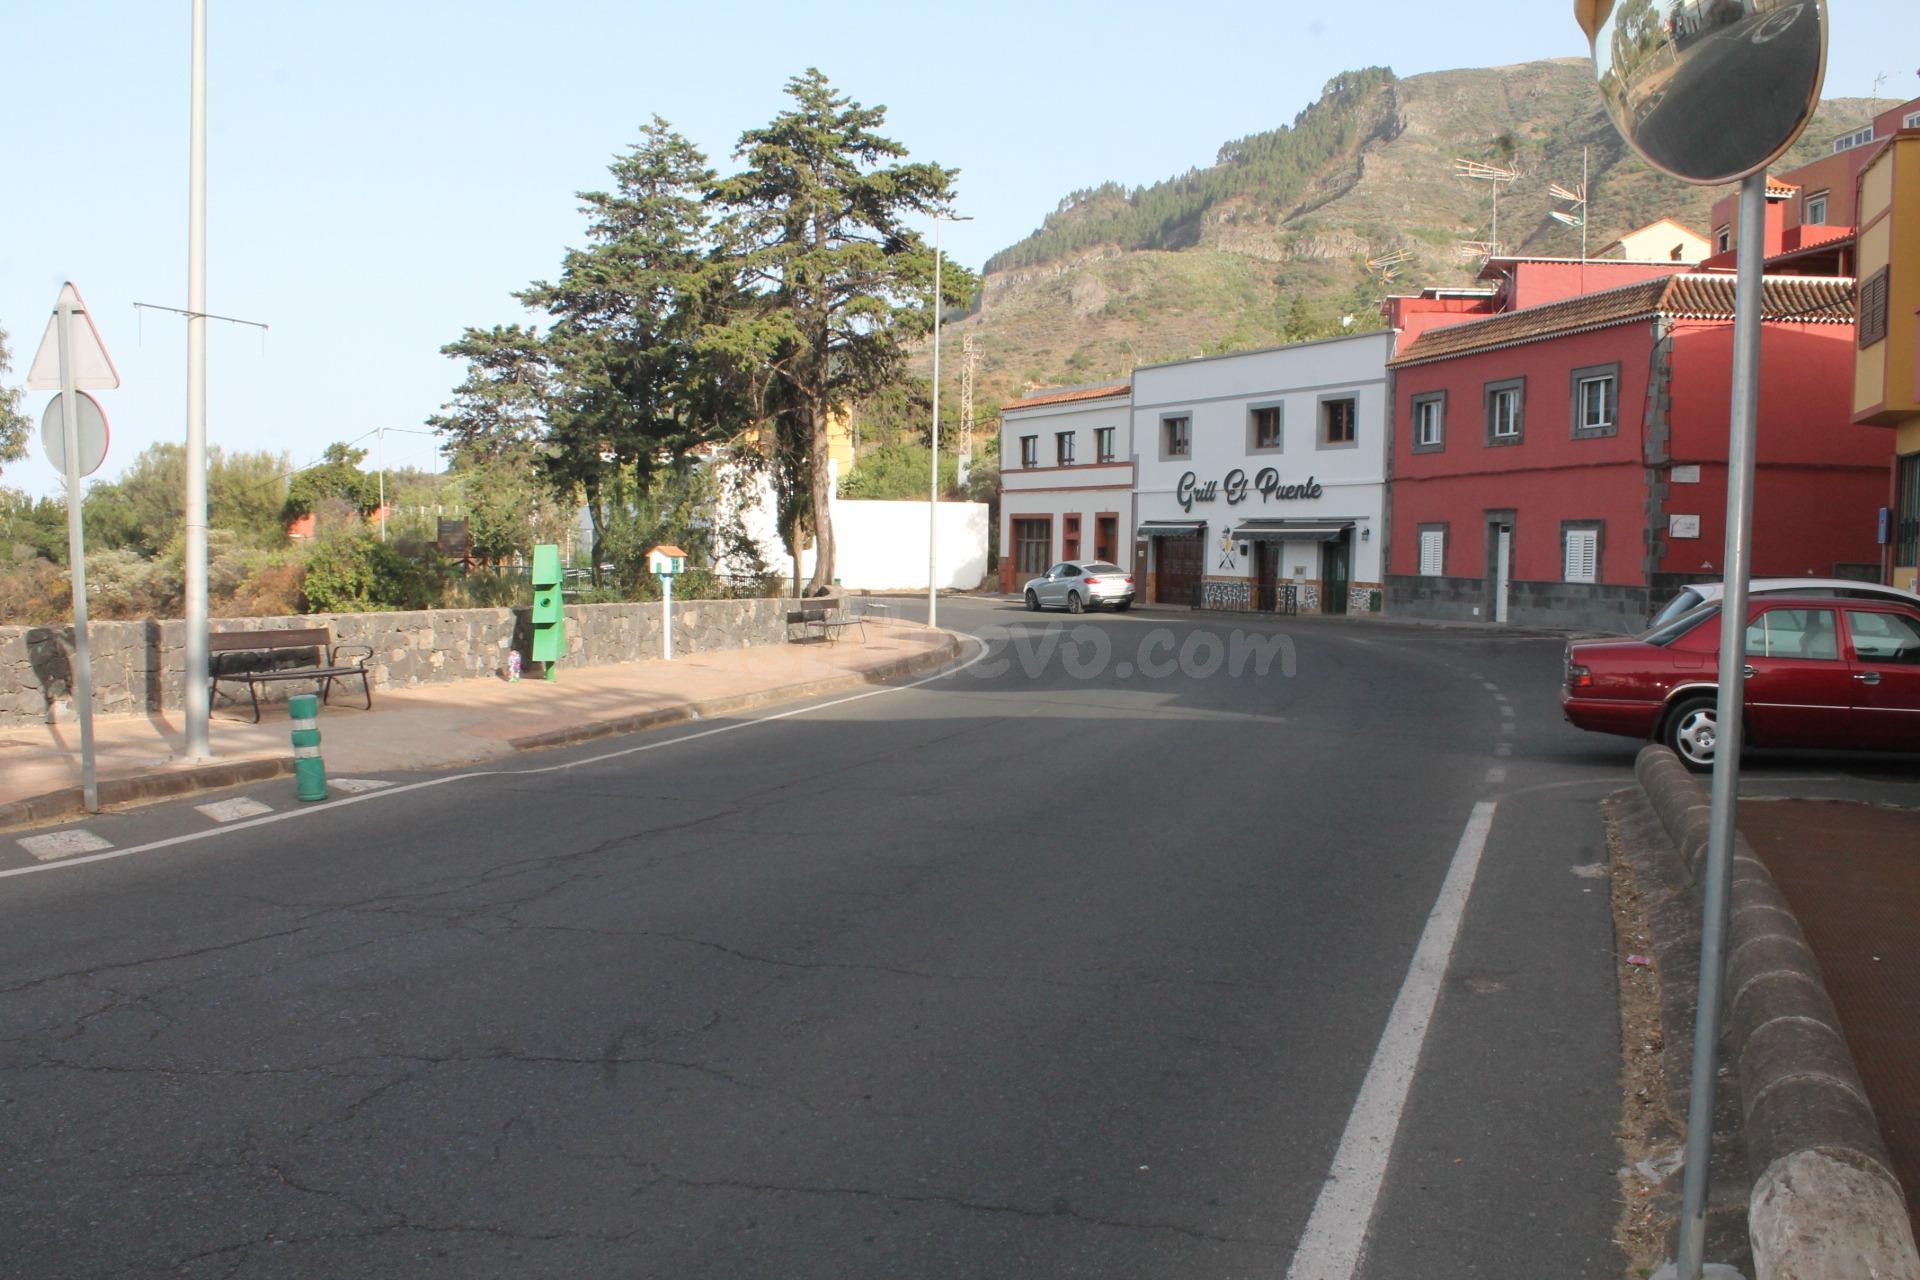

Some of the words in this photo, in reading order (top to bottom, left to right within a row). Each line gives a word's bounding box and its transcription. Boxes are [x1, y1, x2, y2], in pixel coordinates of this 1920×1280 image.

[1177, 471, 1218, 513] Grill
[1224, 468, 1249, 505] El
[1255, 467, 1323, 504] Puente
